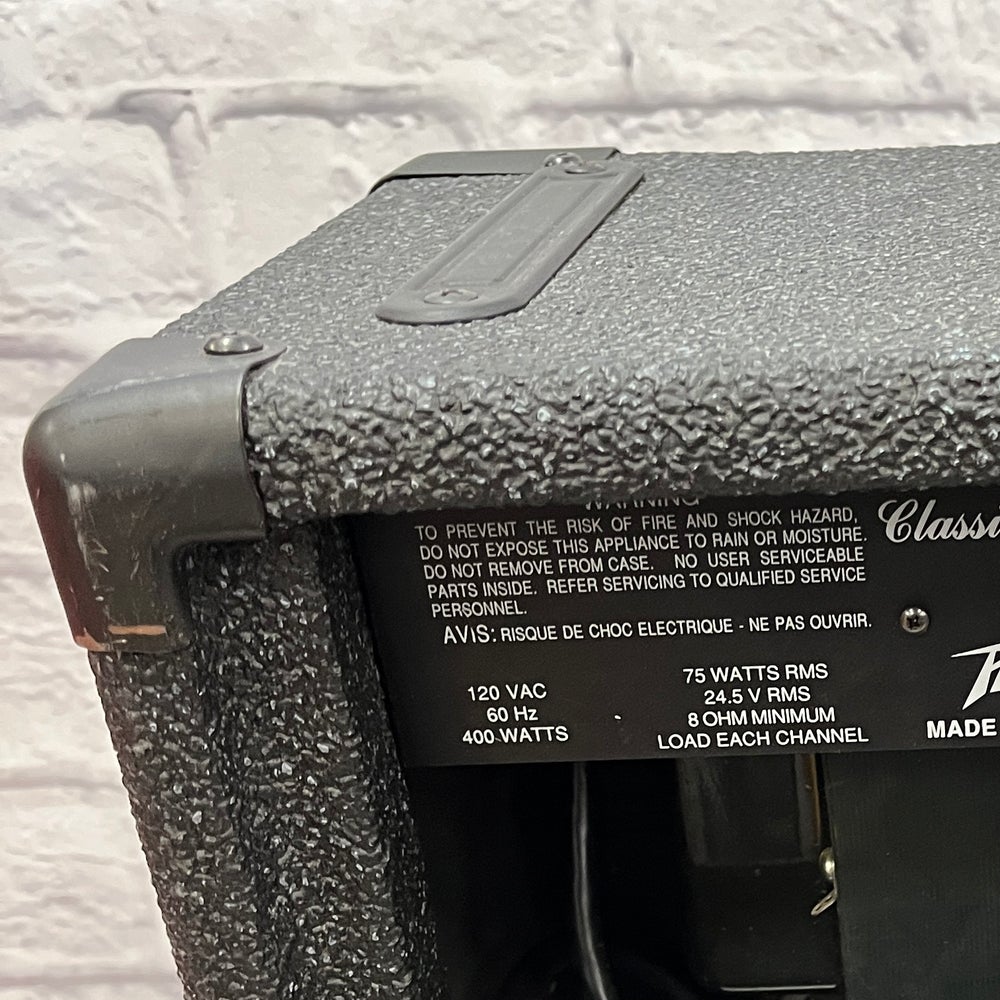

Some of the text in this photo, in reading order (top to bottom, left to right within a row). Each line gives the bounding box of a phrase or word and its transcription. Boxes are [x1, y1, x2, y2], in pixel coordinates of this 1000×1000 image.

[414, 507, 858, 541] TO PREVENT THE RISK OF FIRE AND SHOCK HAZARD,
[419, 526, 868, 561] DO NOT EXPOSE THIS APPLIANCE TO RAIN OR MOISTURE.
[423, 546, 865, 580] DO NOT REMOVE FROM CASE. NO USER SERVICEABLE
[427, 566, 867, 599] PARTS INSIDE. REFER SERVICING TO QUALIFIED SERVICE
[431, 600, 528, 618] PERSONNEL.
[443, 623, 497, 645] AVIS:
[500, 625, 558, 642] RISQUE
[562, 624, 585, 640] DE
[588, 622, 633, 639] CHOC
[637, 618, 734, 637] ELECTRIQUE
[748, 616, 770, 632] NE
[774, 615, 805, 631] PAS
[809, 612, 872, 630] OUVRIR.
[682, 662, 829, 684] 75 WATTS RMS
[467, 682, 547, 702] 120 VAC
[703, 685, 811, 705] 24.5 V RMS
[486, 705, 539, 723] 60 Hz
[687, 706, 836, 728] 8 OHM MINIMUM
[462, 725, 569, 745] 400 WATTS
[657, 726, 870, 750] LOAD EACH CHANNEL
[926, 718, 998, 739] MADE
